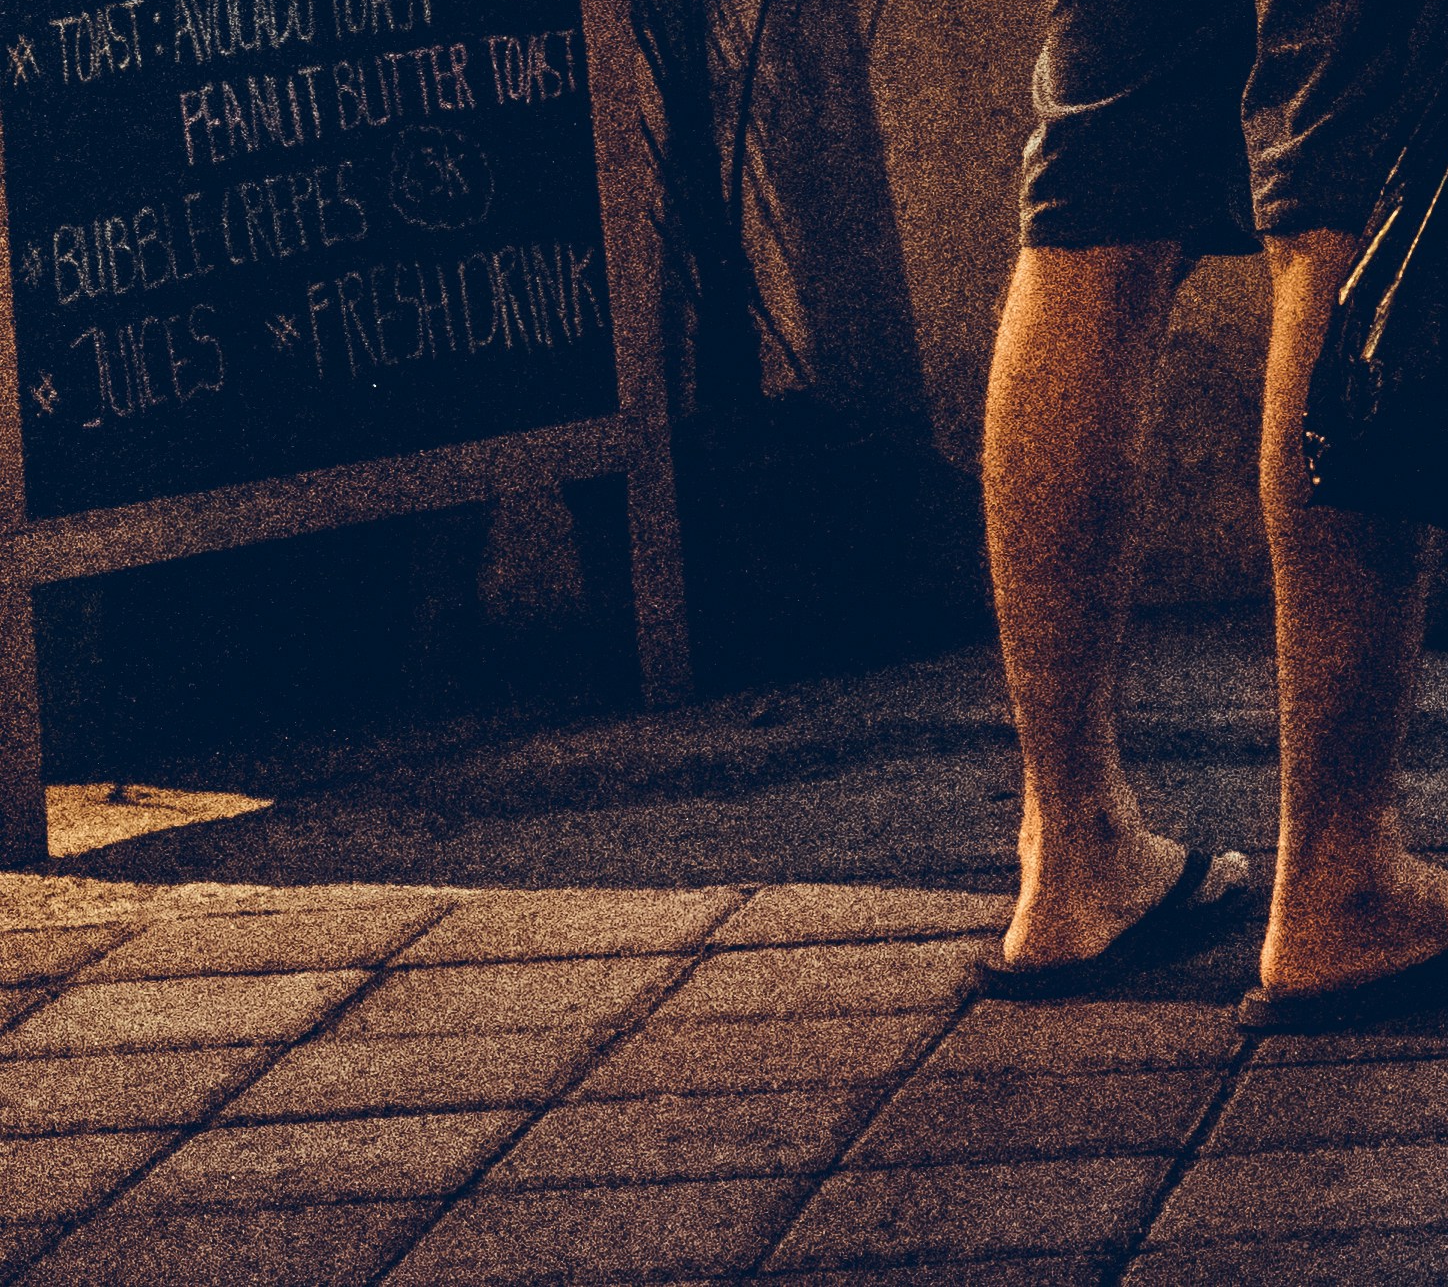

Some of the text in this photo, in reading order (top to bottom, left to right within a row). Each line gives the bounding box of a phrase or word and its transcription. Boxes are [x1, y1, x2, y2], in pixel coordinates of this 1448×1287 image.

[179, 29, 578, 165] PEANUT BUTTER TOAST
[220, 158, 370, 266] CREPES
